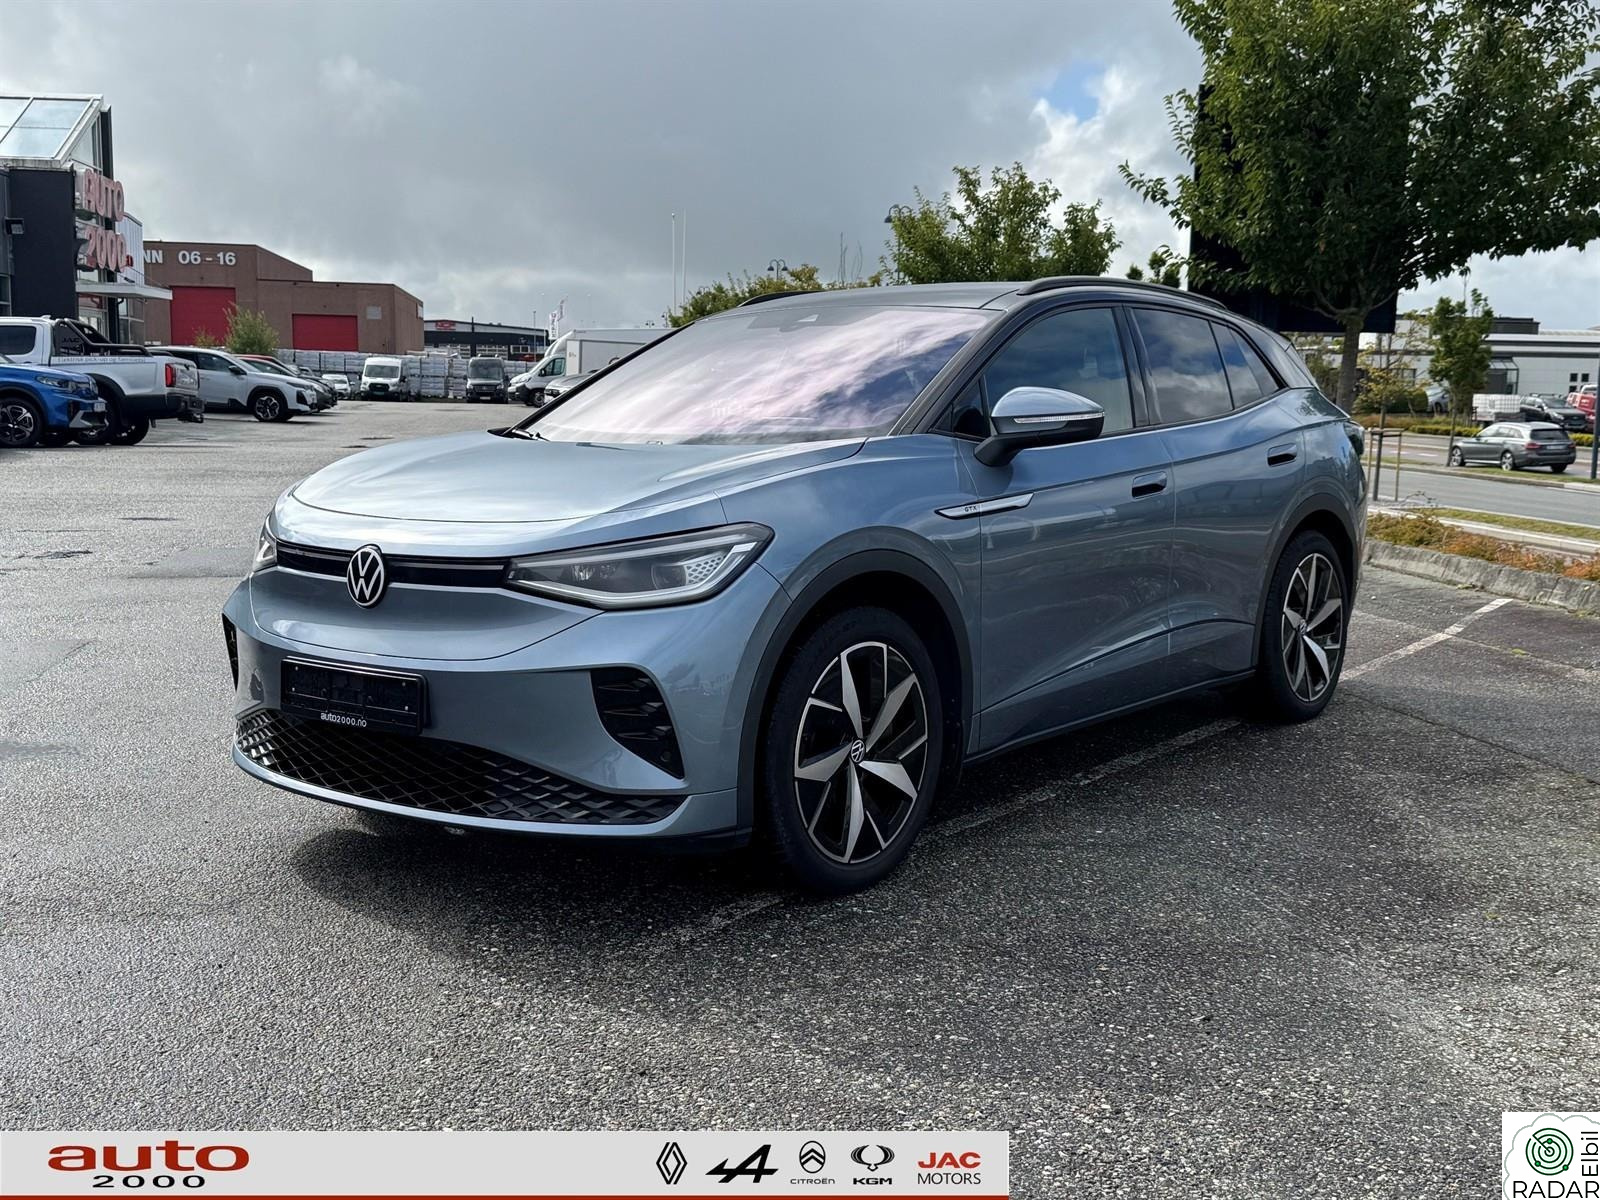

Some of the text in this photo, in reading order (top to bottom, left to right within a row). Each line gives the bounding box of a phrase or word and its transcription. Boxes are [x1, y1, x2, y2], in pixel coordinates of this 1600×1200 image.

[84, 168, 125, 221] AUTO
[85, 226, 127, 272] 2000
[178, 250, 201, 265] 06
[216, 252, 237, 266] 16
[964, 505, 977, 513] GTX
[320, 712, 367, 727] auto2000.no
